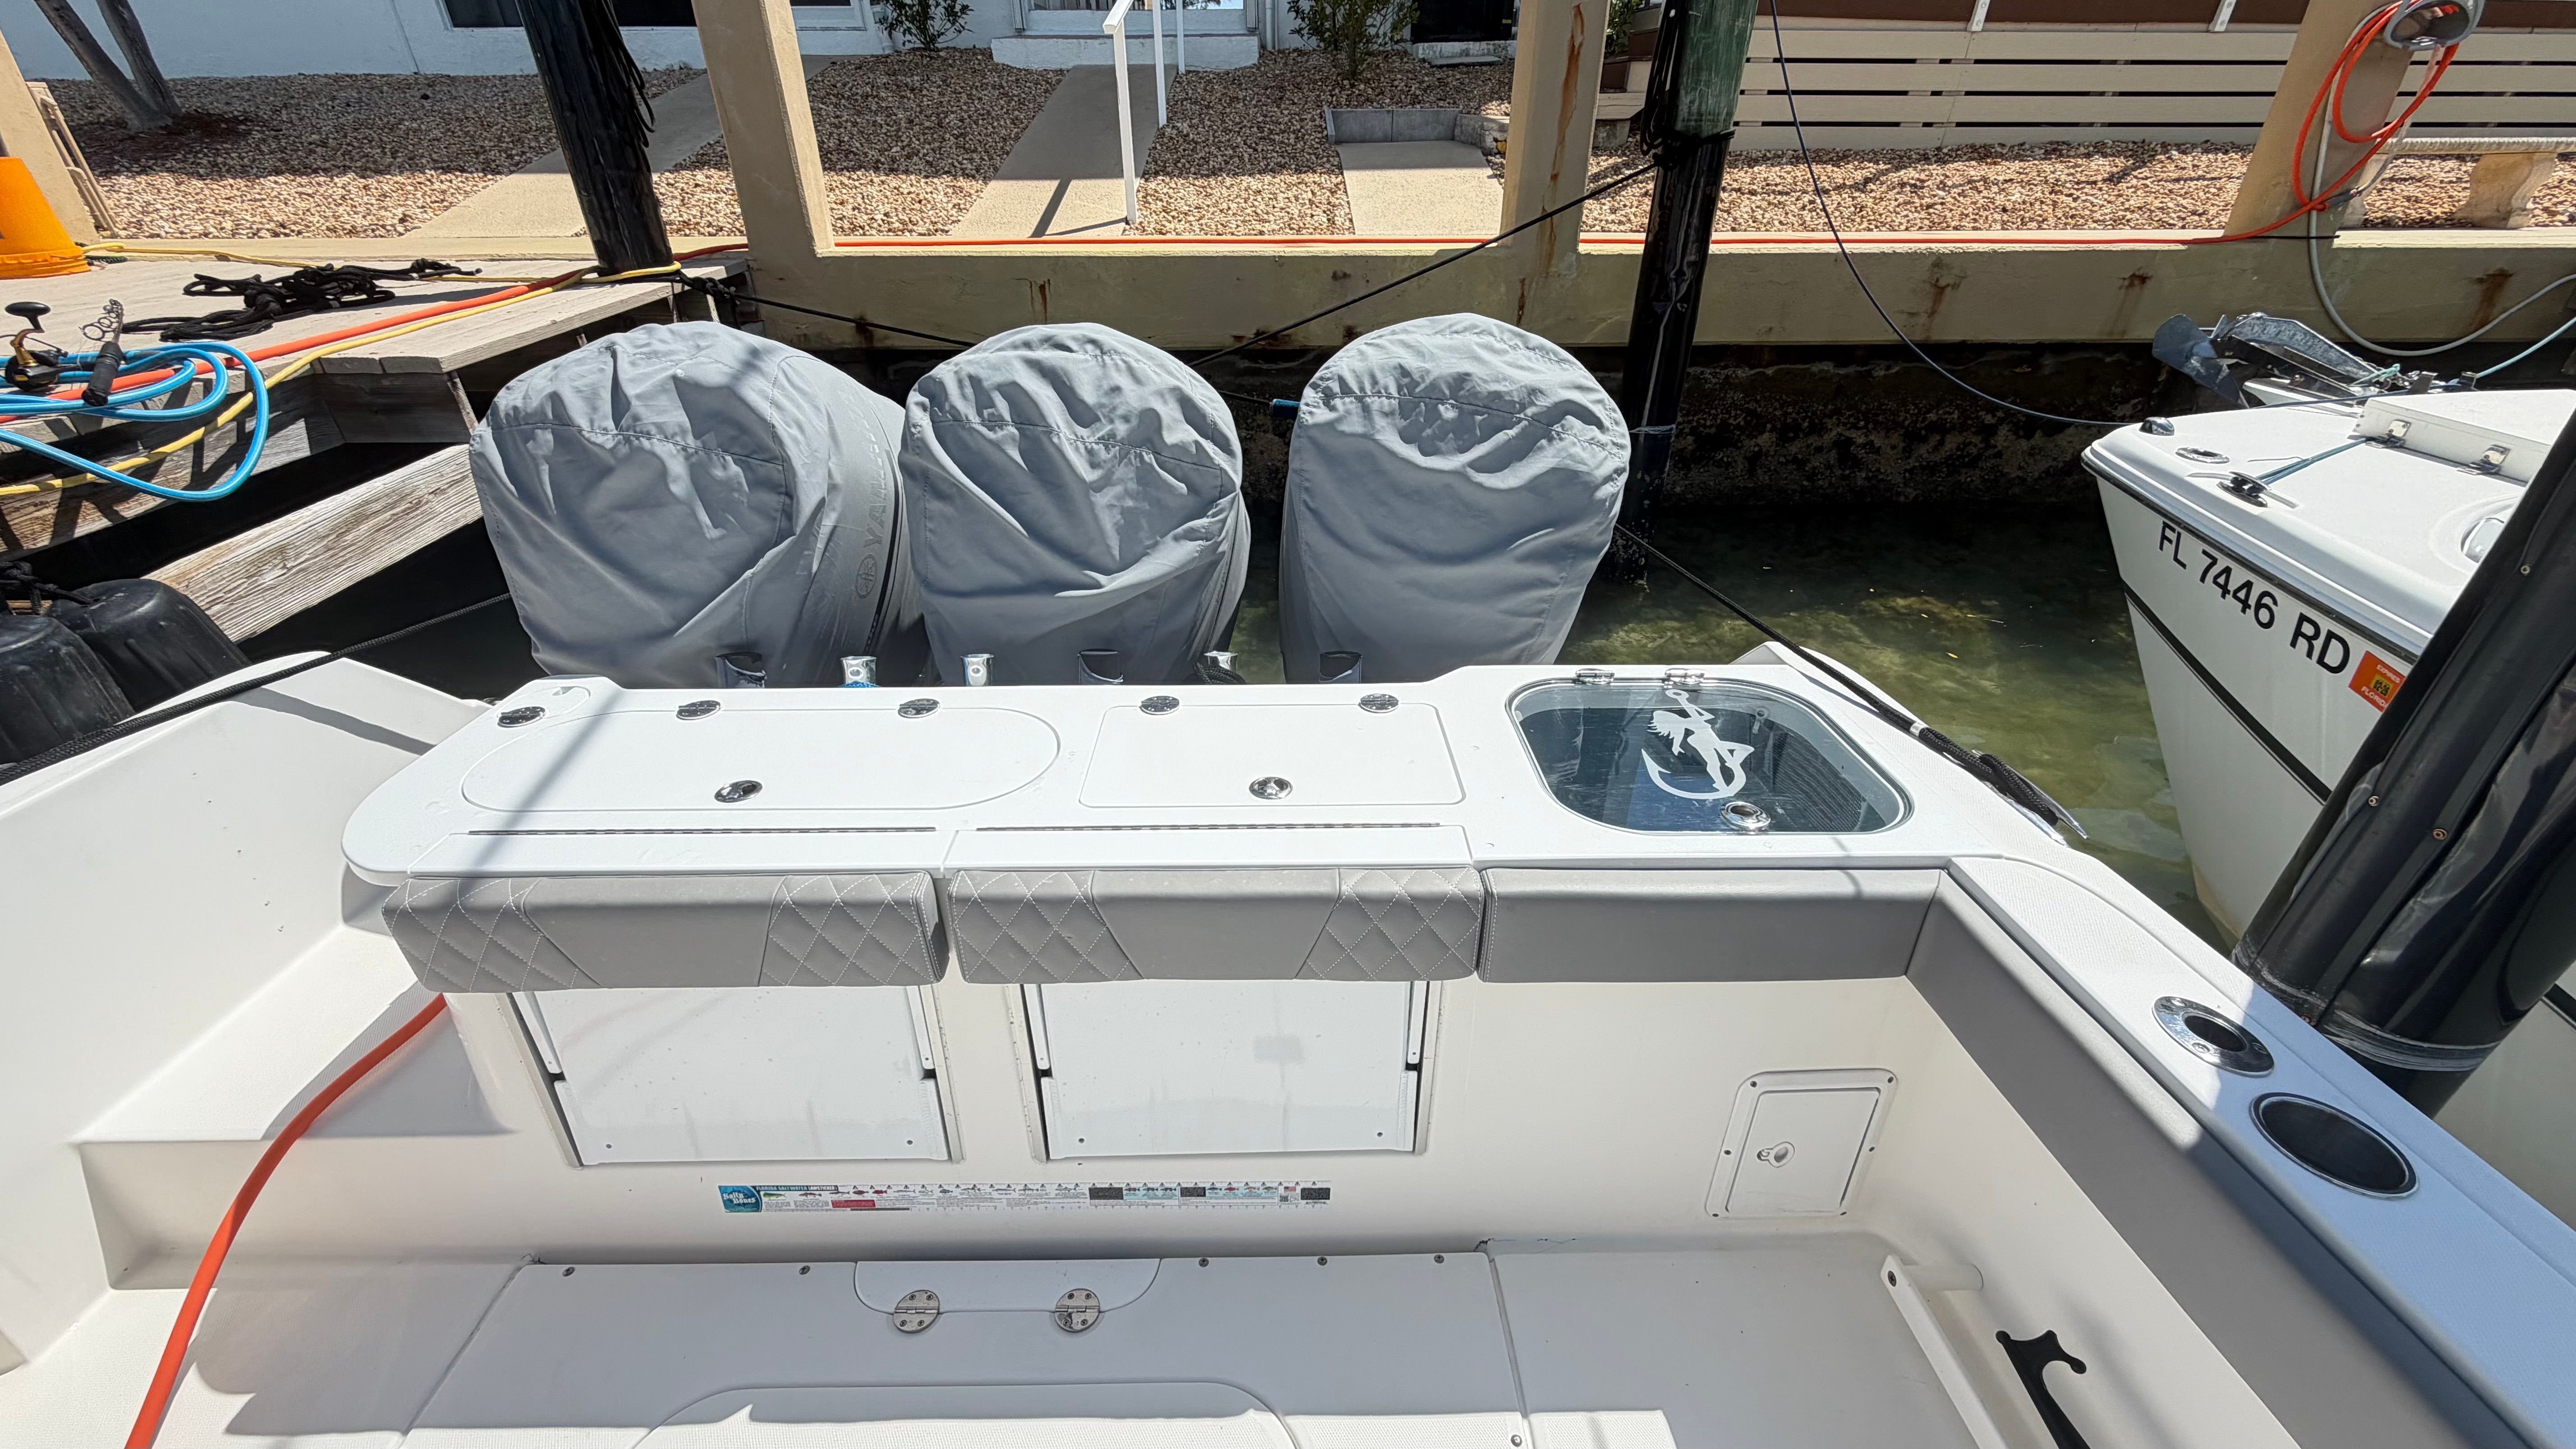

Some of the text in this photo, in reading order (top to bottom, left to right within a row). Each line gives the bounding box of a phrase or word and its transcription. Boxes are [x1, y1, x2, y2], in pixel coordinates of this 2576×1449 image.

[2159, 520, 2351, 674] FL 7446 RD
[2376, 664, 2401, 684] EXPIRES
[723, 1191, 744, 1200] Salty
